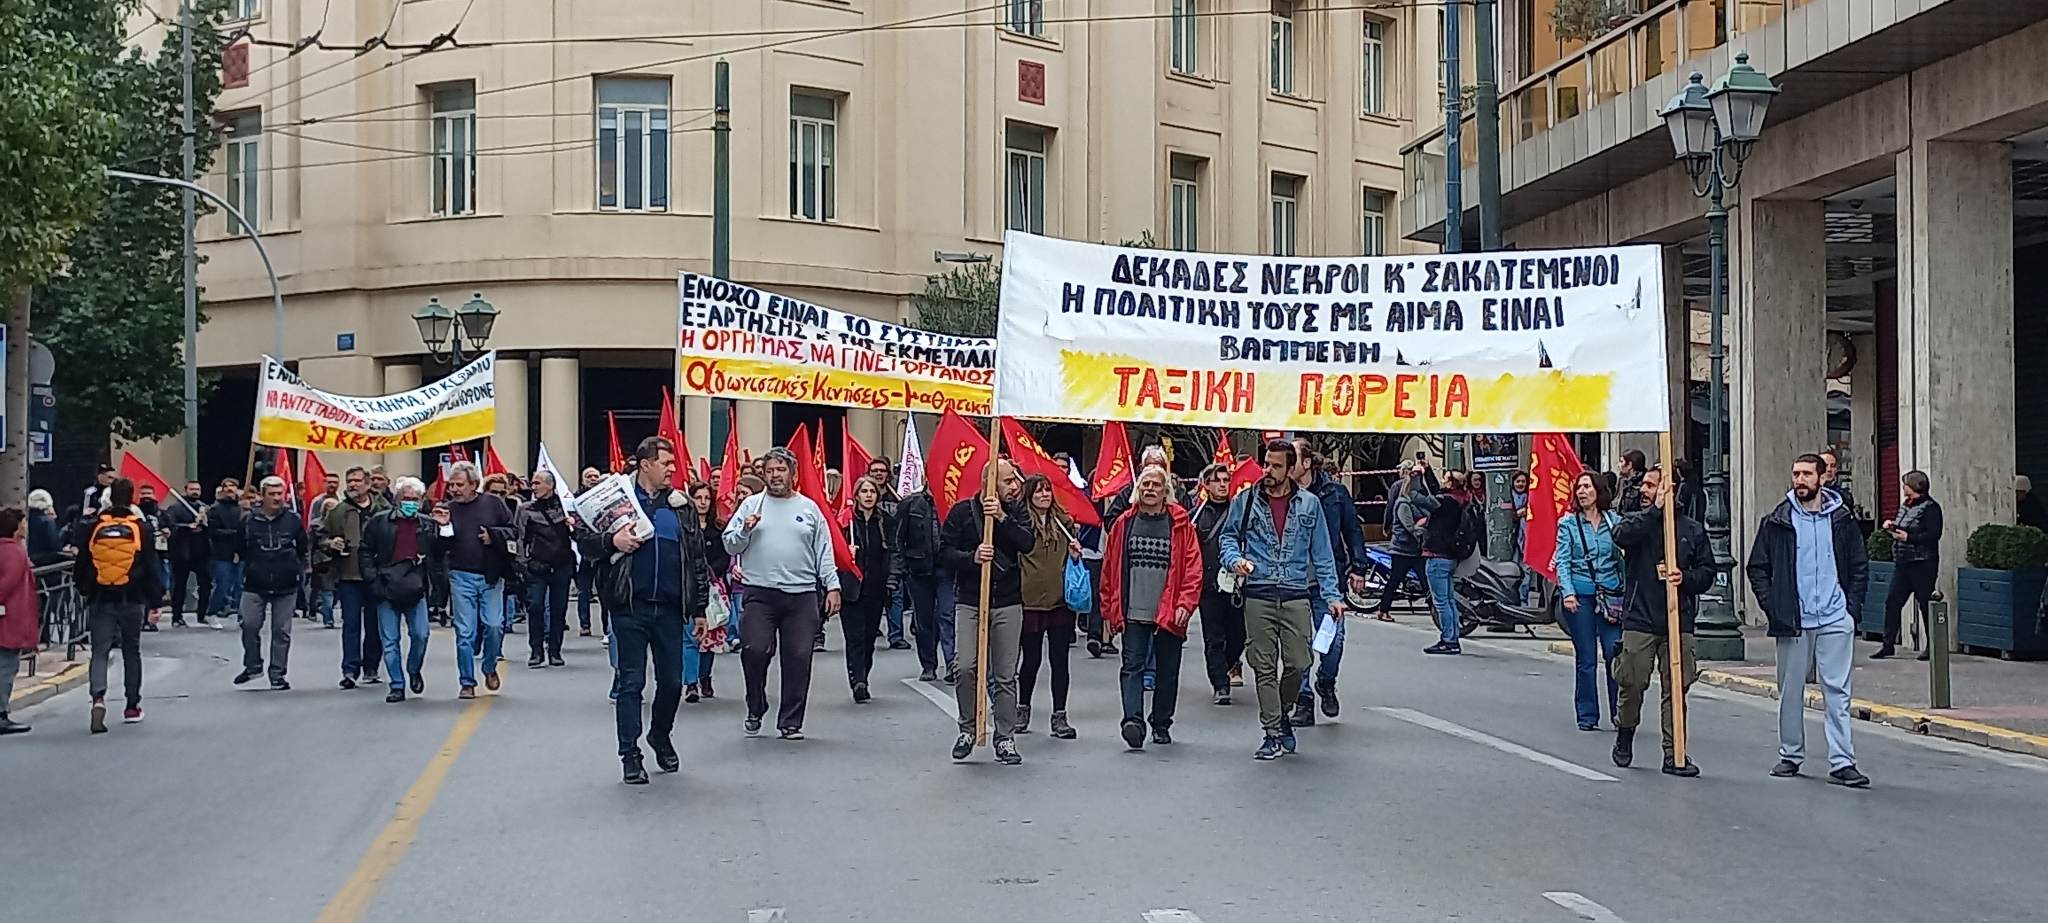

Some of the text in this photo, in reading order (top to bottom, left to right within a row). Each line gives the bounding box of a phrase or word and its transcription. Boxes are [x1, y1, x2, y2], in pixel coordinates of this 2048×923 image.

[1111, 253, 1249, 294] ΔΕΚΑΔΕΣ
[1261, 262, 1369, 295] ΝΕΚΡΟΙ
[1421, 253, 1619, 293] ΣΑΚΑΤΕΜΕΝΟΙ
[682, 301, 807, 340] ΕΞΑΡΤΗΣΗΣ
[683, 273, 990, 347] ΕΝΟΧΟ ΕΙΝΑΙ ΤΟ ΣΥΣΤΗΜΑ
[1062, 282, 1564, 332] Η ΠΟΛΙΤΙΚΗ ΤΟΥΣ ΜΕ ΑΙΜΑ ΕΙΝΑΙ
[681, 329, 695, 348] Η
[702, 330, 756, 354] ΟΡΓΗ
[811, 343, 835, 367] ΝΑ
[842, 347, 896, 372] ΓΙΝΕΙ
[1219, 335, 1381, 364] ΒΑΜΜΕΝΗ
[1113, 366, 1470, 419] ΤΑΞΙΚΗ ΠΟΡΕΙΑ
